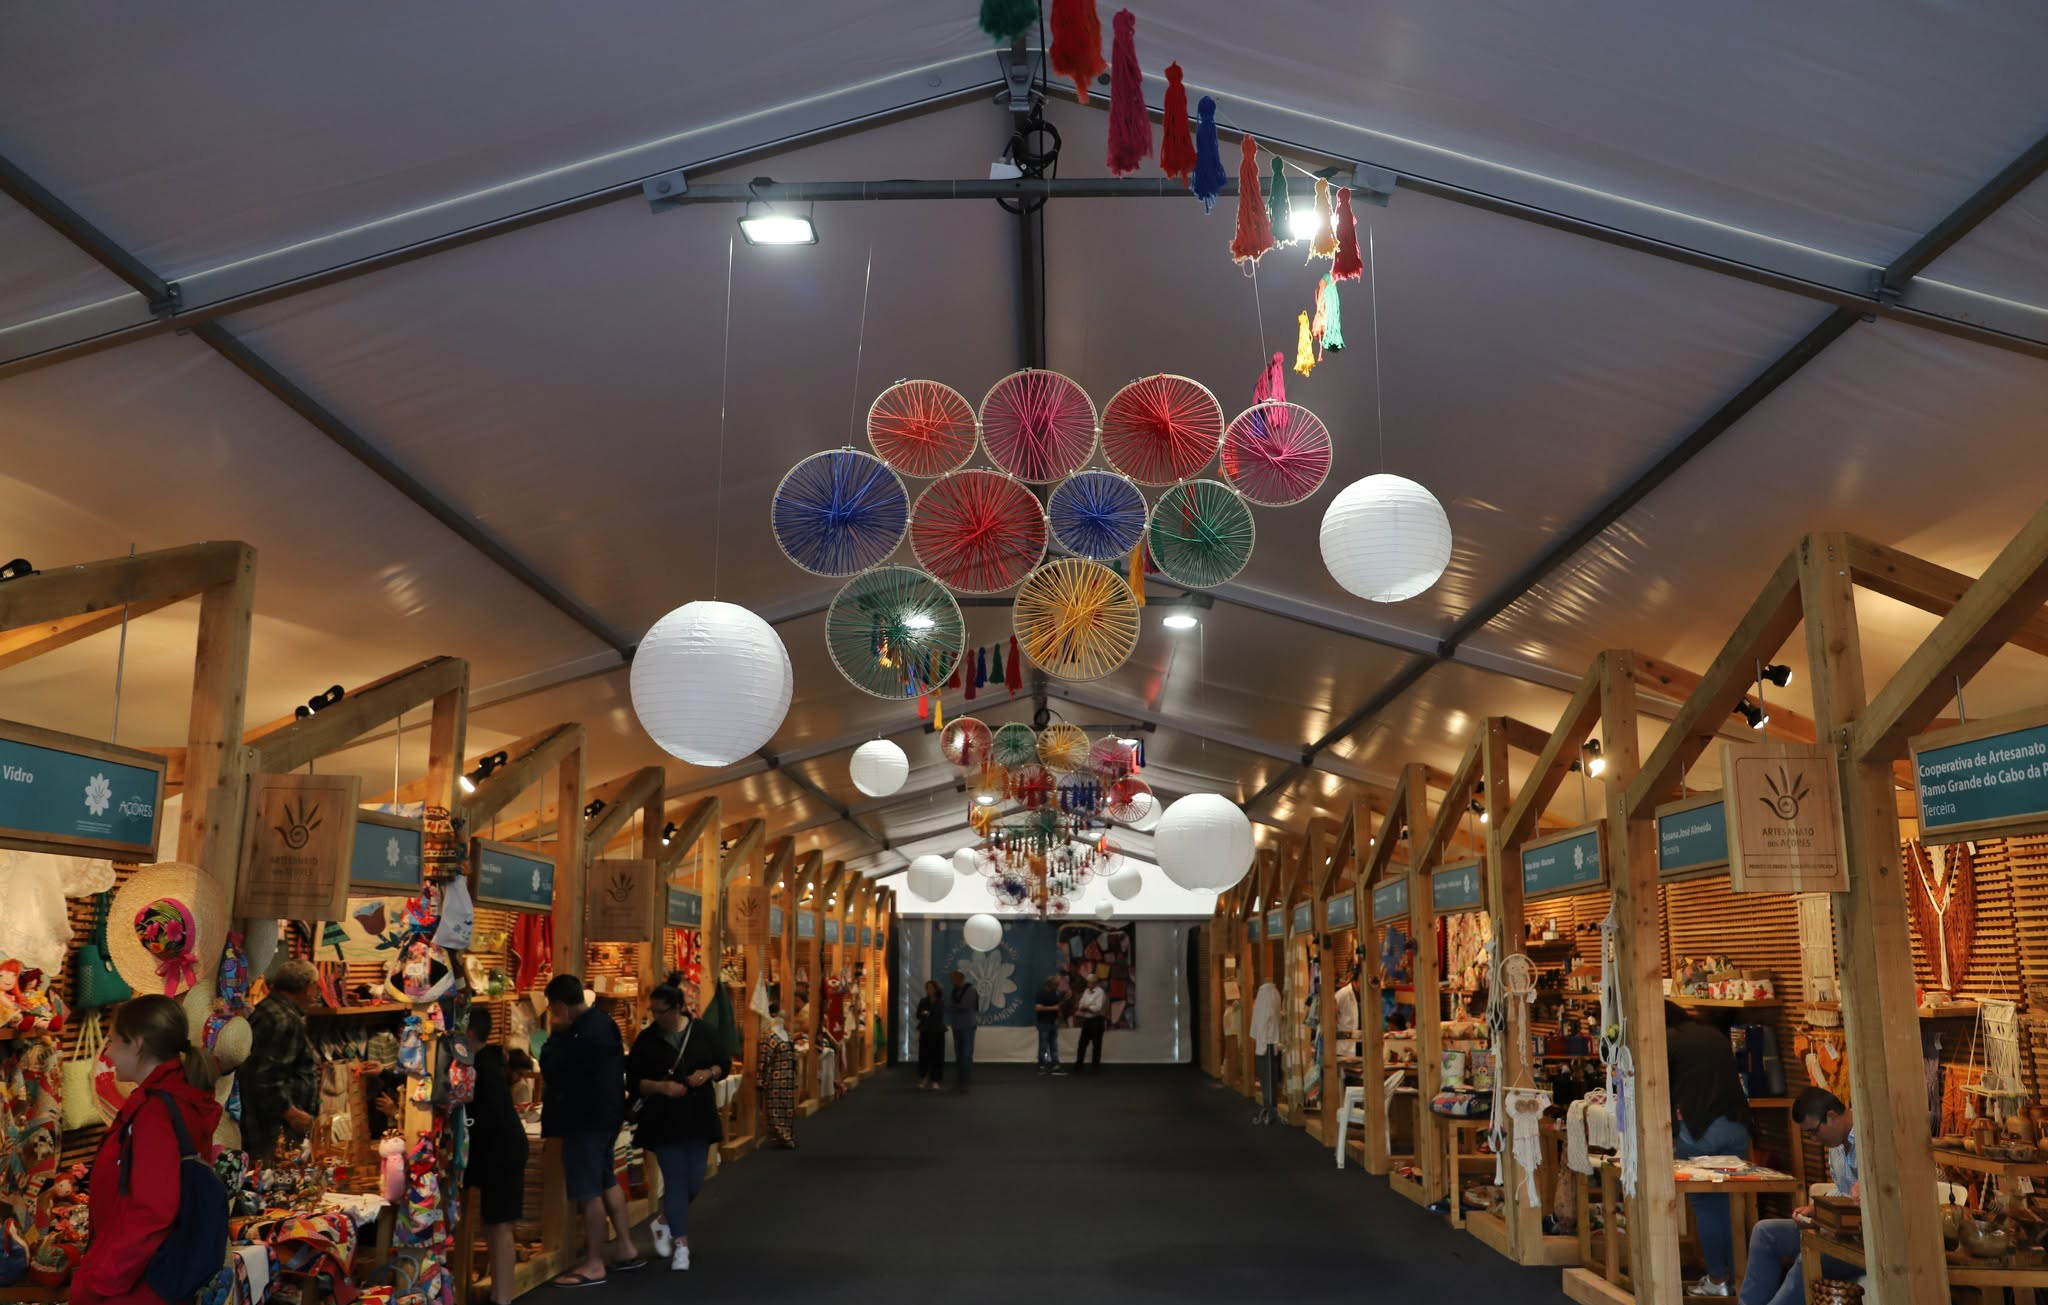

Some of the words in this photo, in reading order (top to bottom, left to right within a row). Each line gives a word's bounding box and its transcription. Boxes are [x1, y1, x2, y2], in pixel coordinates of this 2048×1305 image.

[1919, 757, 1973, 778] Cooperativa
[1974, 753, 1987, 767] de
[1989, 742, 2046, 764] Artesanato
[2, 764, 34, 784] Vidro
[1921, 784, 1947, 798] Ramo
[1947, 775, 1982, 793] Grande
[1983, 772, 1997, 786] do
[1998, 767, 2025, 784] Cabo
[2027, 764, 2041, 779] da
[118, 801, 153, 818] AÇORES
[1923, 802, 1956, 817] Terceira
[1762, 827, 1815, 837] ARTESANATO
